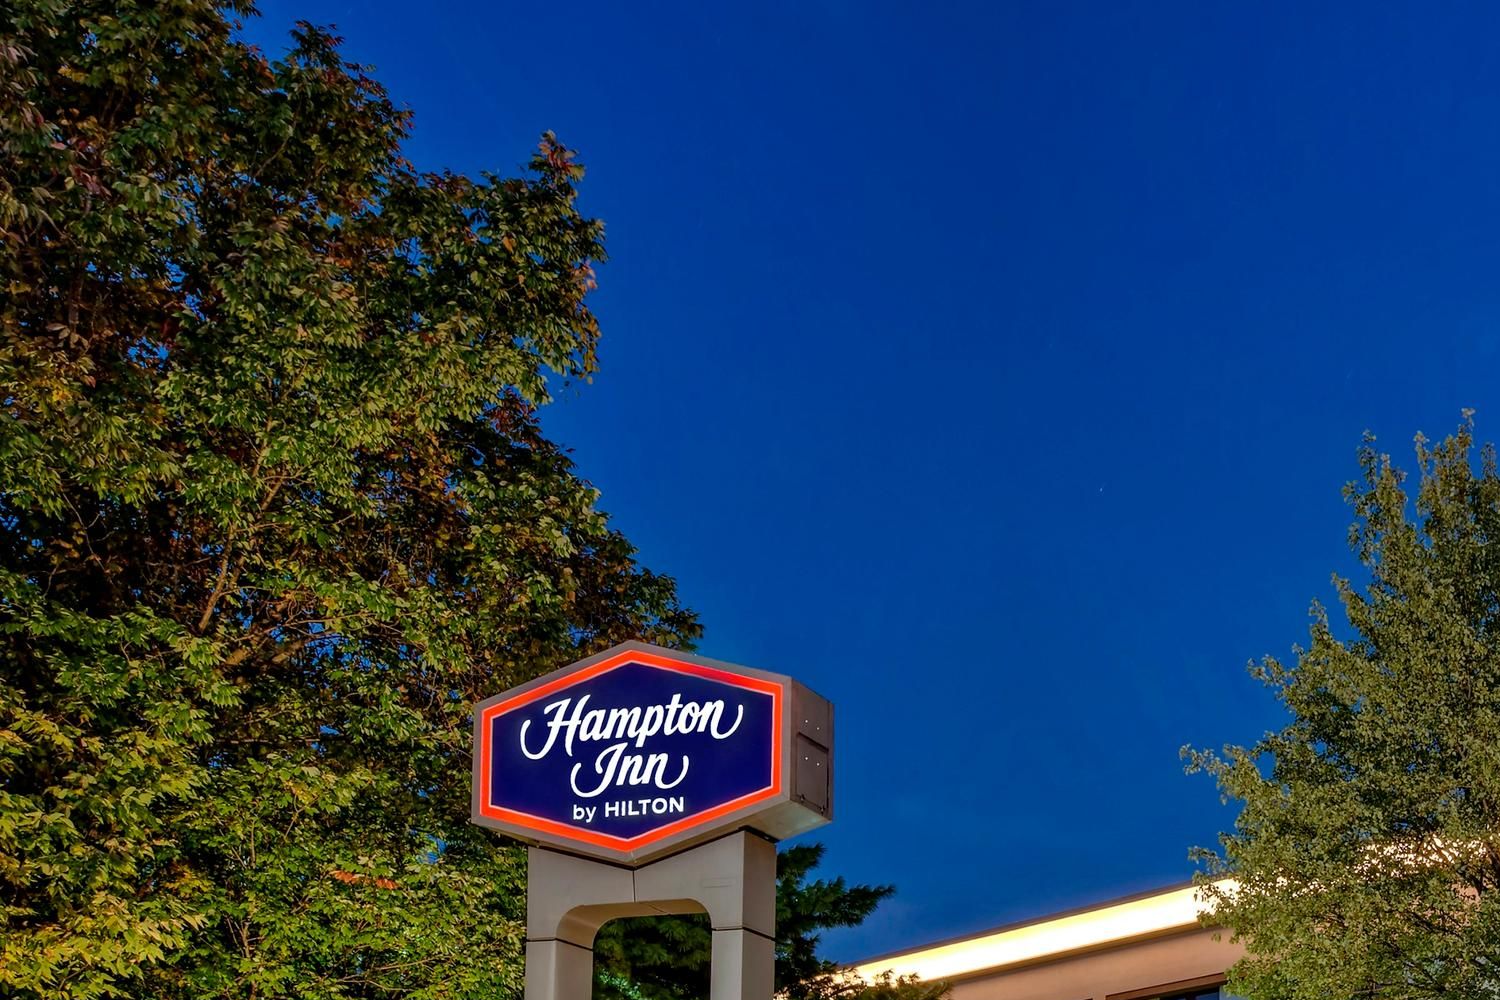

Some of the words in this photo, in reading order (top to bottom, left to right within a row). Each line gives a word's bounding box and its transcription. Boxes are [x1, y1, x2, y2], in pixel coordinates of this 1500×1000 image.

[520, 693, 744, 760] Hampton
[570, 742, 689, 797] Inn
[572, 802, 597, 823] by
[604, 796, 685, 818] HILTON
